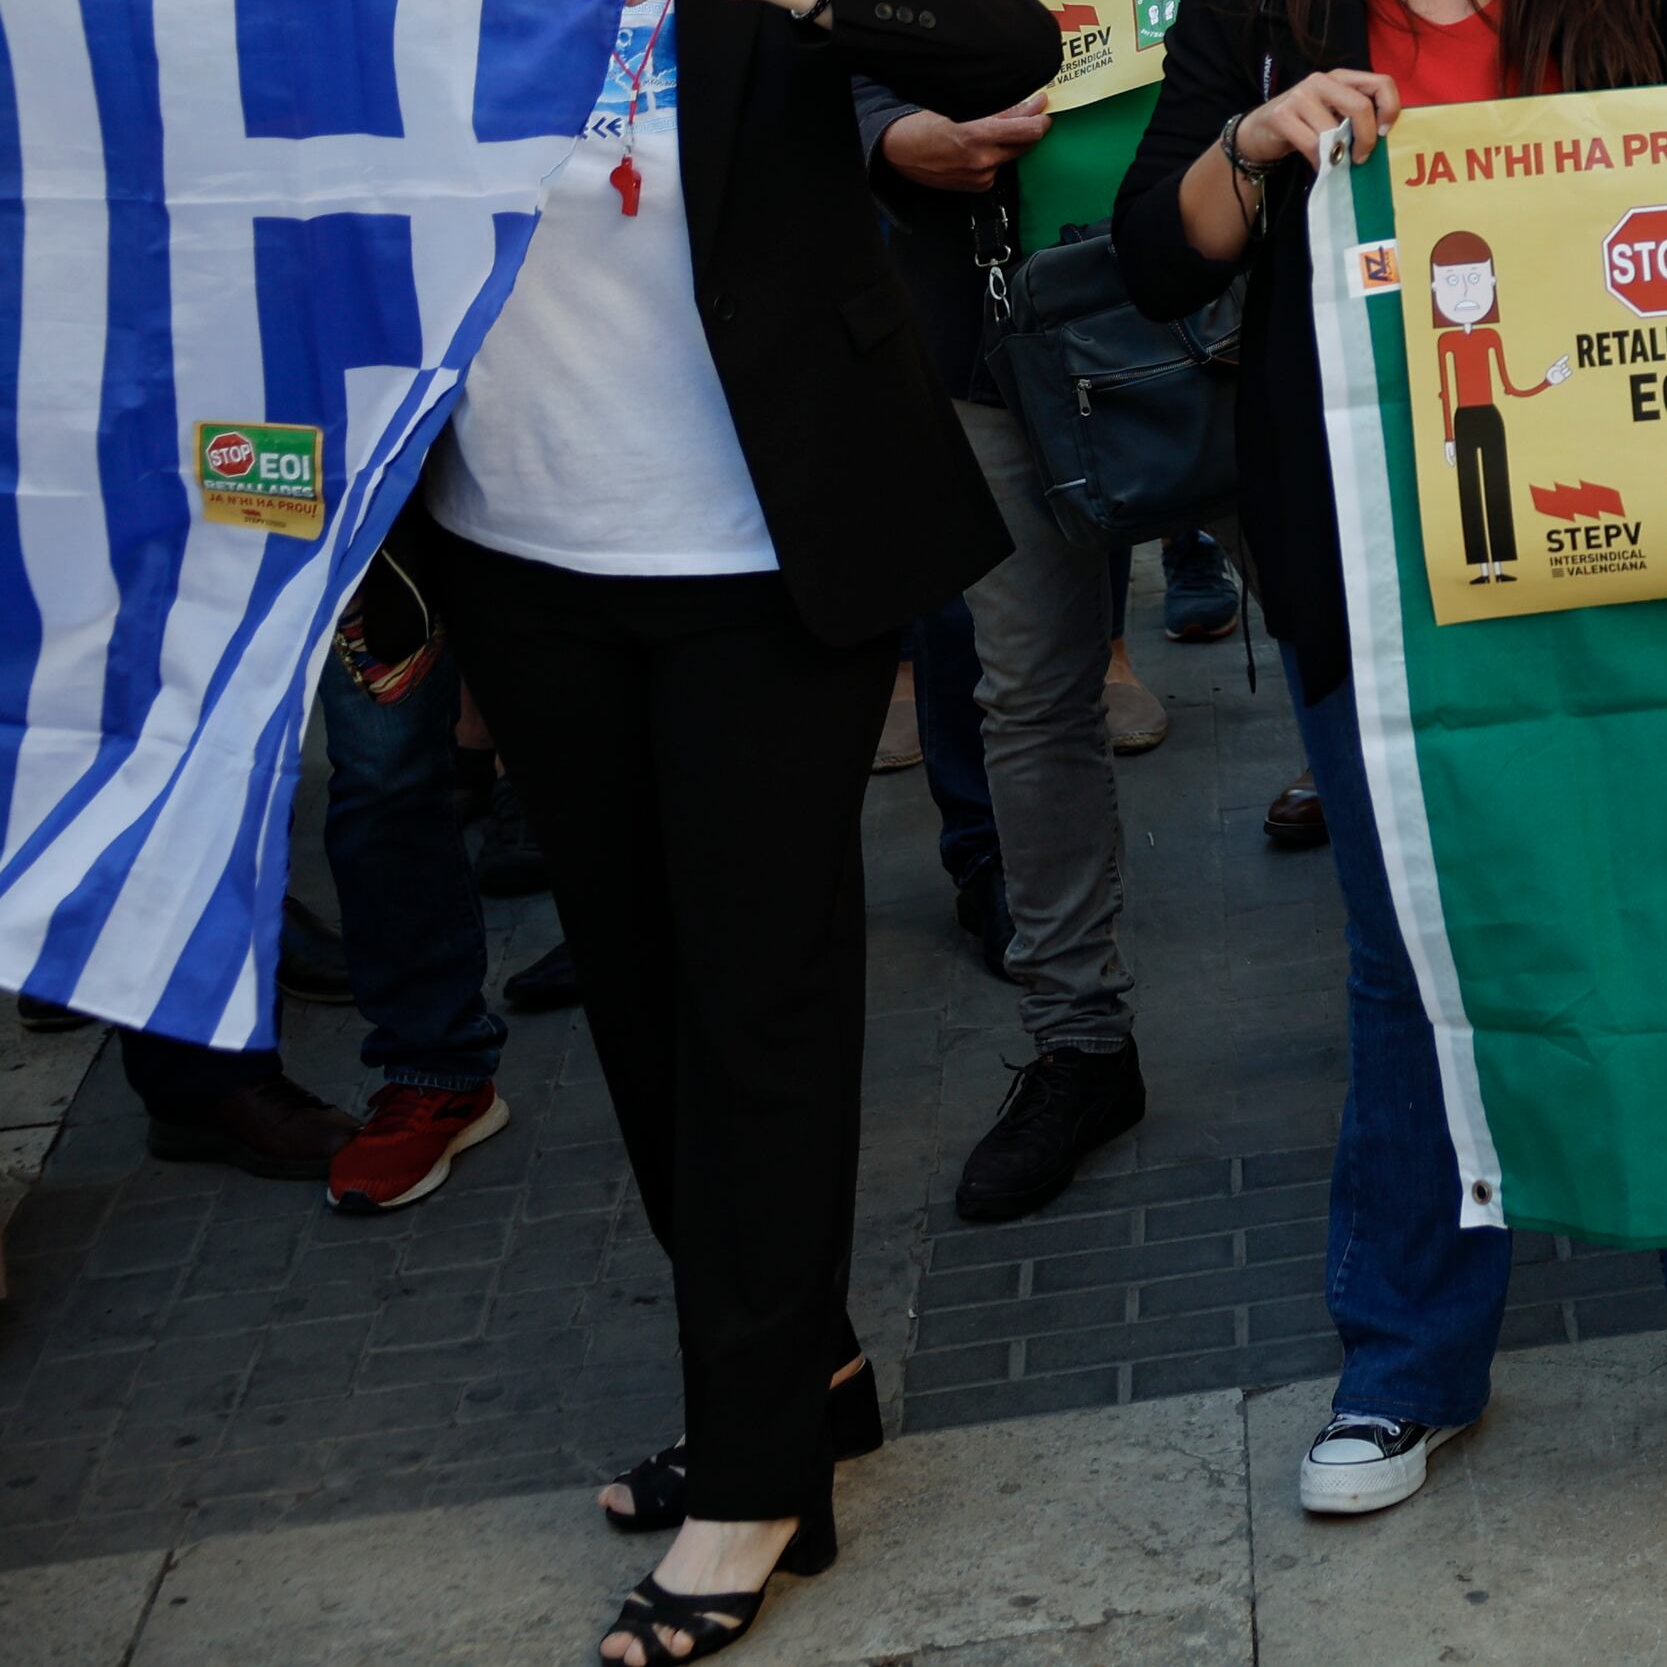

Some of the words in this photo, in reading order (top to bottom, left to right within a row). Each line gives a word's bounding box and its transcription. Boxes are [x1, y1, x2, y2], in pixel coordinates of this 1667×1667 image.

[1056, 56, 1114, 85] VALENCIANA
[1404, 150, 1458, 188] JA
[1465, 142, 1545, 181] N'HI
[1554, 137, 1615, 173] HA
[210, 444, 250, 467] STOP
[260, 452, 311, 481] EOI
[203, 479, 315, 498] RETALLADES
[278, 500, 319, 519] PROU!
[1546, 521, 1642, 553] STEPV
[1549, 549, 1647, 567] INTERSINDICAL
[1567, 560, 1648, 577] VALENCIANA
